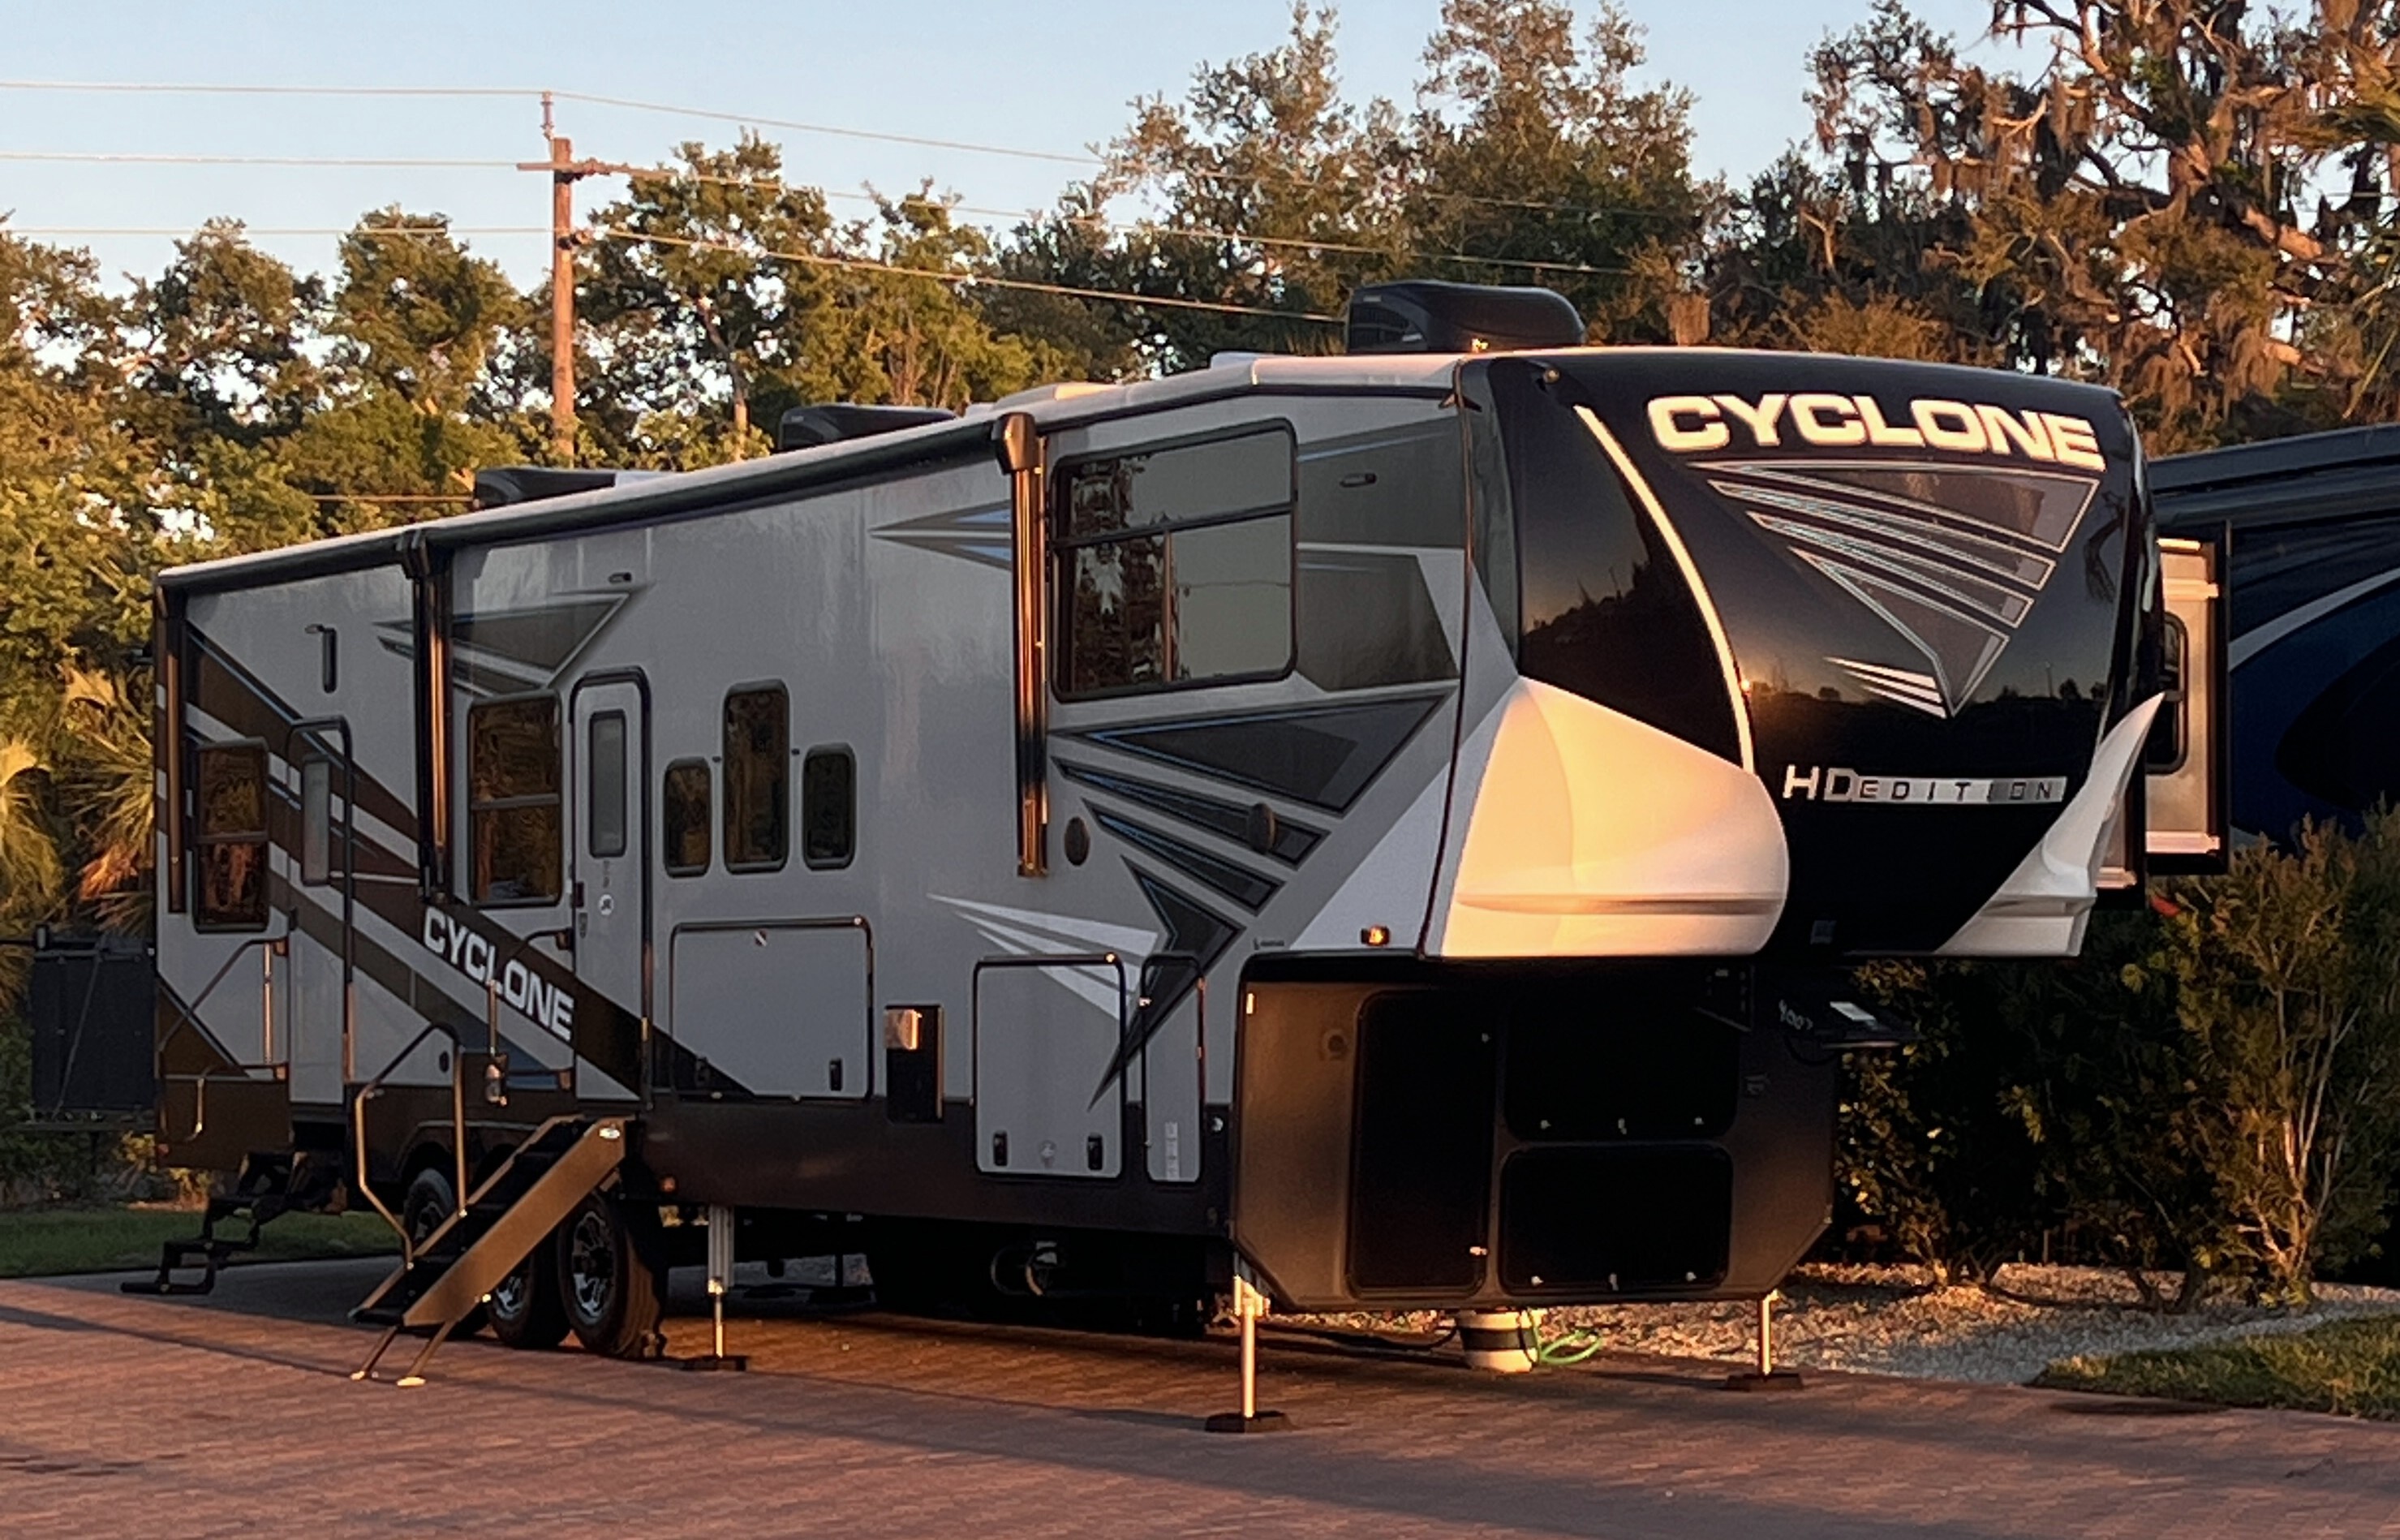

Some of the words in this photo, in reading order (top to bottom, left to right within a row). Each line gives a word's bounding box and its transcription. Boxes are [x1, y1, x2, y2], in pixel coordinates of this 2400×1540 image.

[1647, 394, 2105, 471] CYCLONE
[1783, 764, 1856, 802] HD
[1858, 779, 2054, 802] EDITION
[424, 906, 574, 1041] CYCLONE
